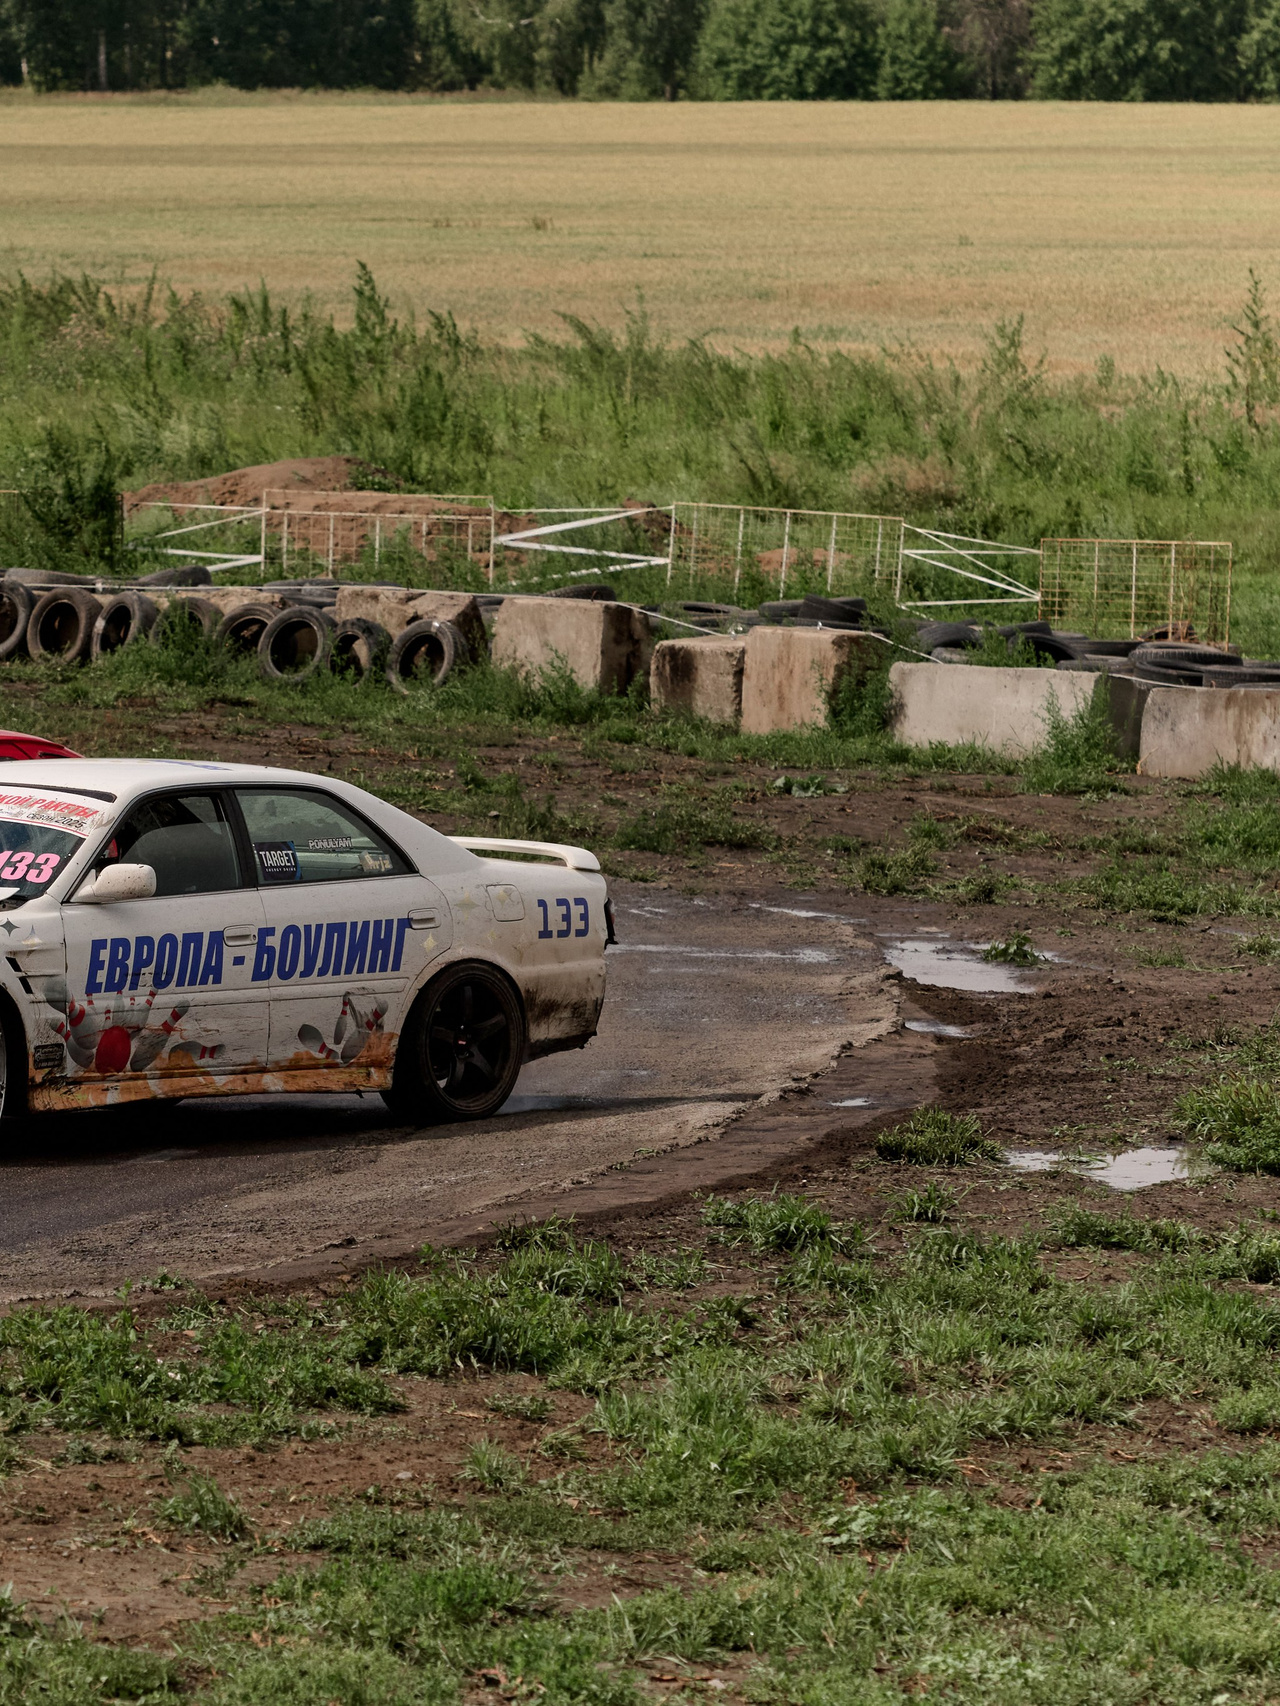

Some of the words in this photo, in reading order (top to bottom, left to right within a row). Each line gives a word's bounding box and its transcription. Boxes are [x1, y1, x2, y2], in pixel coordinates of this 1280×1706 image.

[28, 798, 99, 818] РАКЕТЫ
[55, 816, 87, 829] 2025
[259, 850, 296, 867] TARGET
[537, 897, 590, 939] 133
[85, 930, 225, 994] ЕВРОПА
[251, 917, 414, 982] БОУЛИНГ
